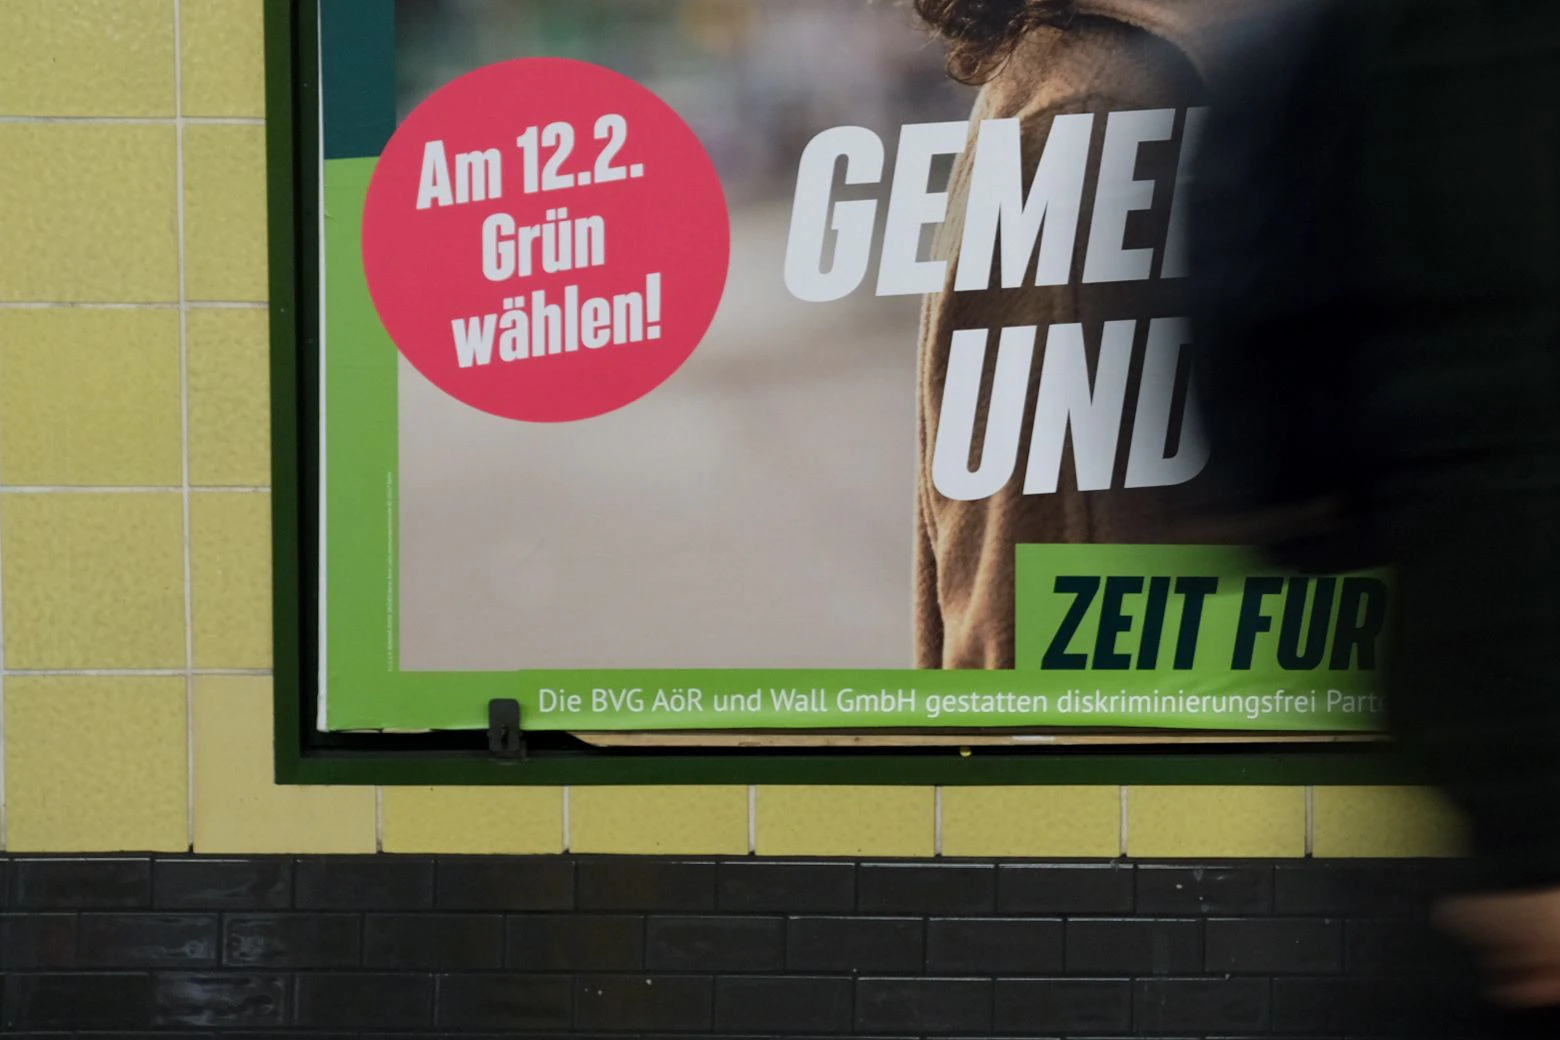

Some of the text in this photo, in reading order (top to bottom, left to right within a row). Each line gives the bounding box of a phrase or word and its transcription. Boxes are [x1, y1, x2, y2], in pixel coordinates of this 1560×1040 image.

[416, 113, 644, 210] Am 12.2.
[783, 107, 1212, 302] GEMEI
[481, 207, 606, 282] Grün
[451, 272, 661, 369] wählen!
[931, 317, 1212, 502] UND
[1040, 575, 1220, 671] ZEIT
[538, 688, 582, 713] Die
[591, 688, 645, 713] BVG
[651, 688, 703, 712] AöR
[713, 687, 762, 712] und
[770, 688, 828, 713] Wall
[836, 688, 917, 712] GmbH
[925, 689, 1048, 718] gestatten
[1056, 688, 1316, 719] diskriminierungsfrei
